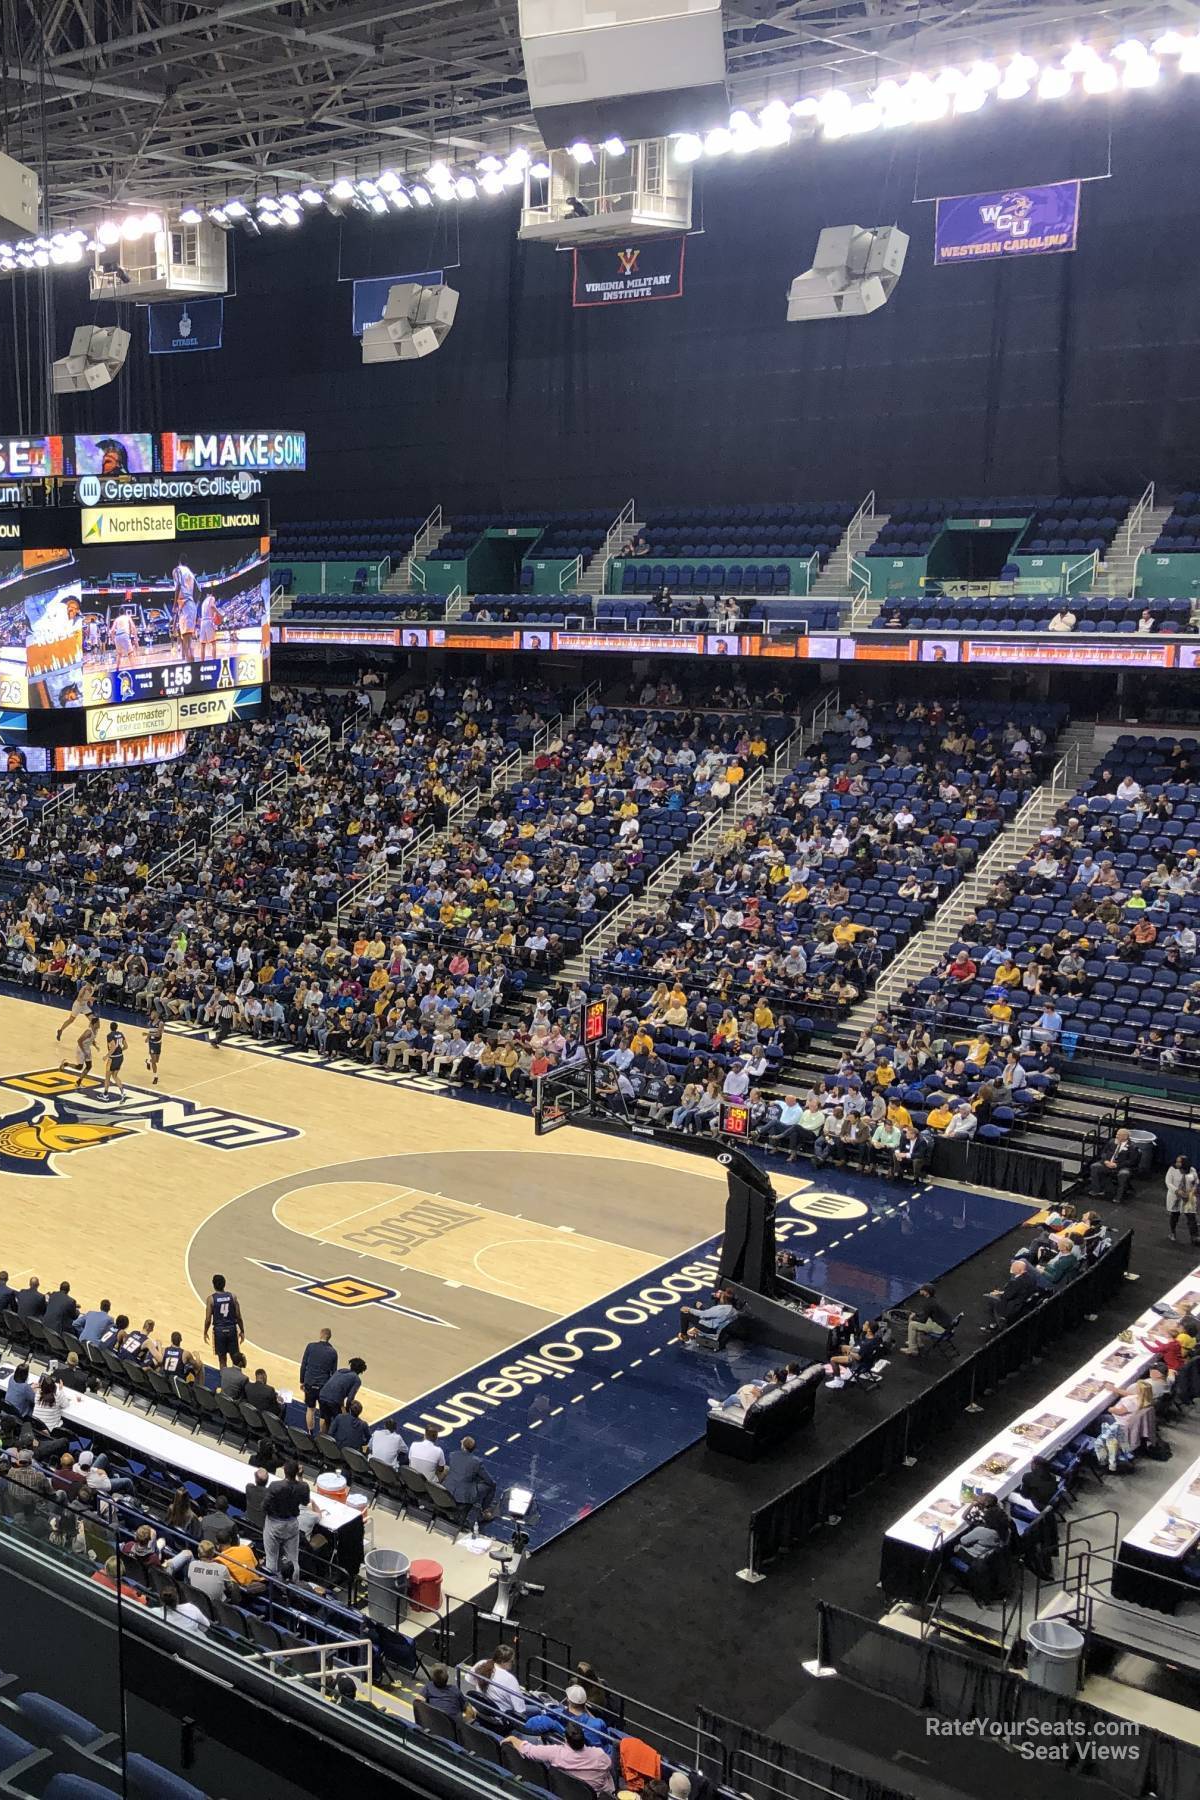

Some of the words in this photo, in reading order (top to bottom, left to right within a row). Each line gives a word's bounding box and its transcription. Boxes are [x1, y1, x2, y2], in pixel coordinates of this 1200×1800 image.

[980, 205, 1030, 236] WCU
[941, 242, 1001, 257] WESTERN
[1004, 234, 1067, 250] CAROLINA
[586, 280, 624, 292] VIRGINIA
[627, 275, 671, 288] MILITARY
[603, 288, 651, 300] INSTITUTE
[194, 434, 269, 466] MAKE
[105, 479, 193, 499] Greensboro
[198, 477, 261, 496] Coliseum
[109, 517, 173, 533] NorthState
[177, 513, 222, 531] GREEN
[222, 514, 259, 527] LINCOLN
[161, 666, 192, 687] 1:55
[238, 659, 256, 680] 26
[0, 681, 21, 703] 26
[91, 677, 113, 700] 29
[116, 709, 167, 724] ticketmaster
[180, 703, 226, 716] SEGRA
[143, 720, 165, 729] TICKETS
[591, 1003, 604, 1017] 1:54
[586, 1016, 603, 1038] 30
[731, 1109, 746, 1119] 1:54
[726, 1118, 742, 1131] 30
[220, 1303, 229, 1317] 4
[123, 1337, 140, 1353] 33
[165, 1357, 178, 1371] 13
[403, 1328, 622, 1438] Coliseum
